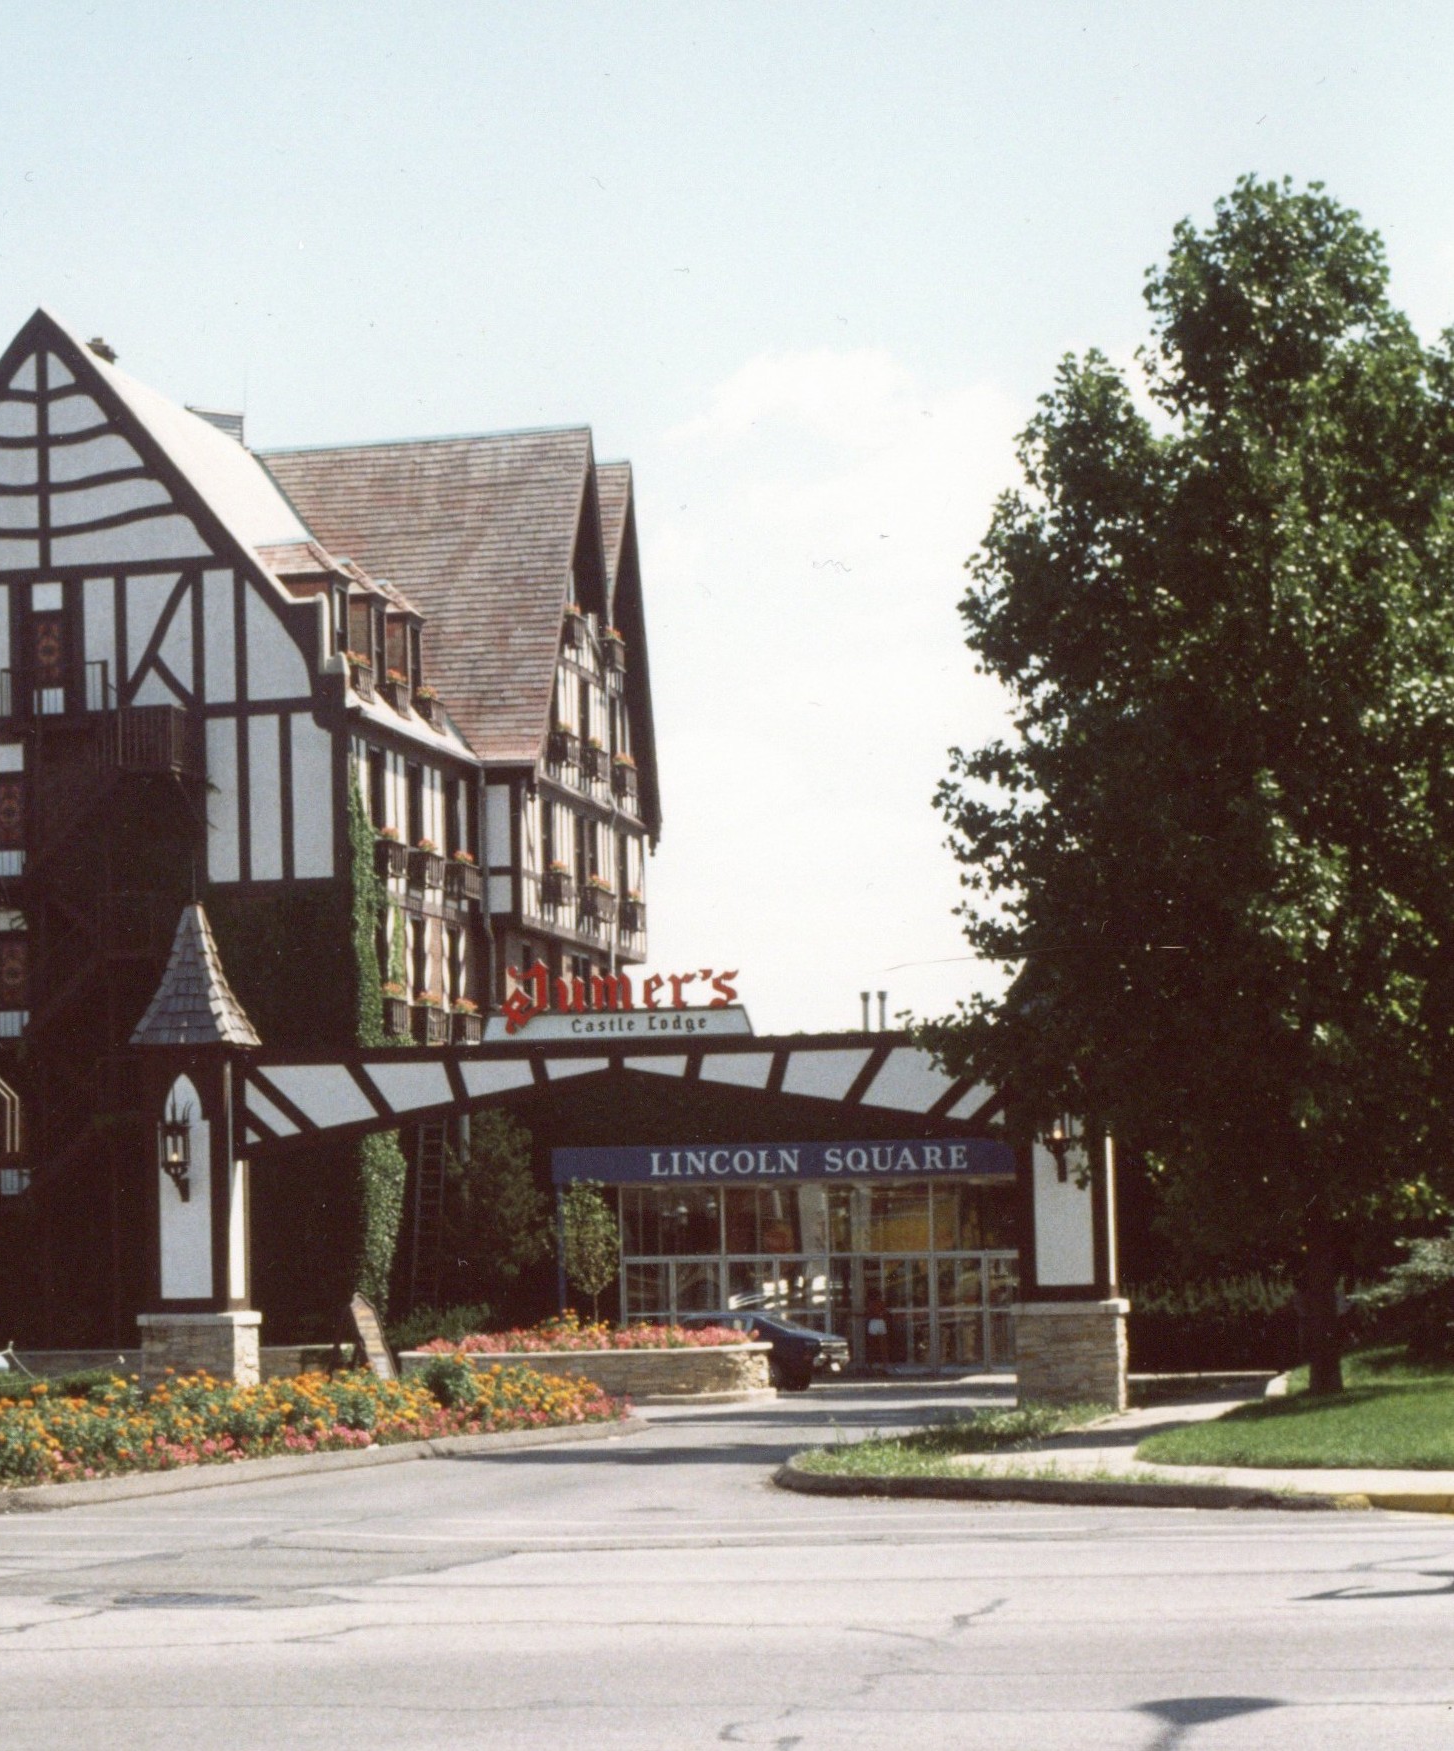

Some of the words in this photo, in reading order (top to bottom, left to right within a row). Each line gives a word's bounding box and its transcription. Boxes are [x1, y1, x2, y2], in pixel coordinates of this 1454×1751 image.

[502, 958, 739, 1035] Jumer's
[571, 1016, 636, 1033] Castle
[648, 1014, 707, 1032] Lodge
[650, 1149, 801, 1176] LINCOLN
[825, 1146, 968, 1173] SQUARE
